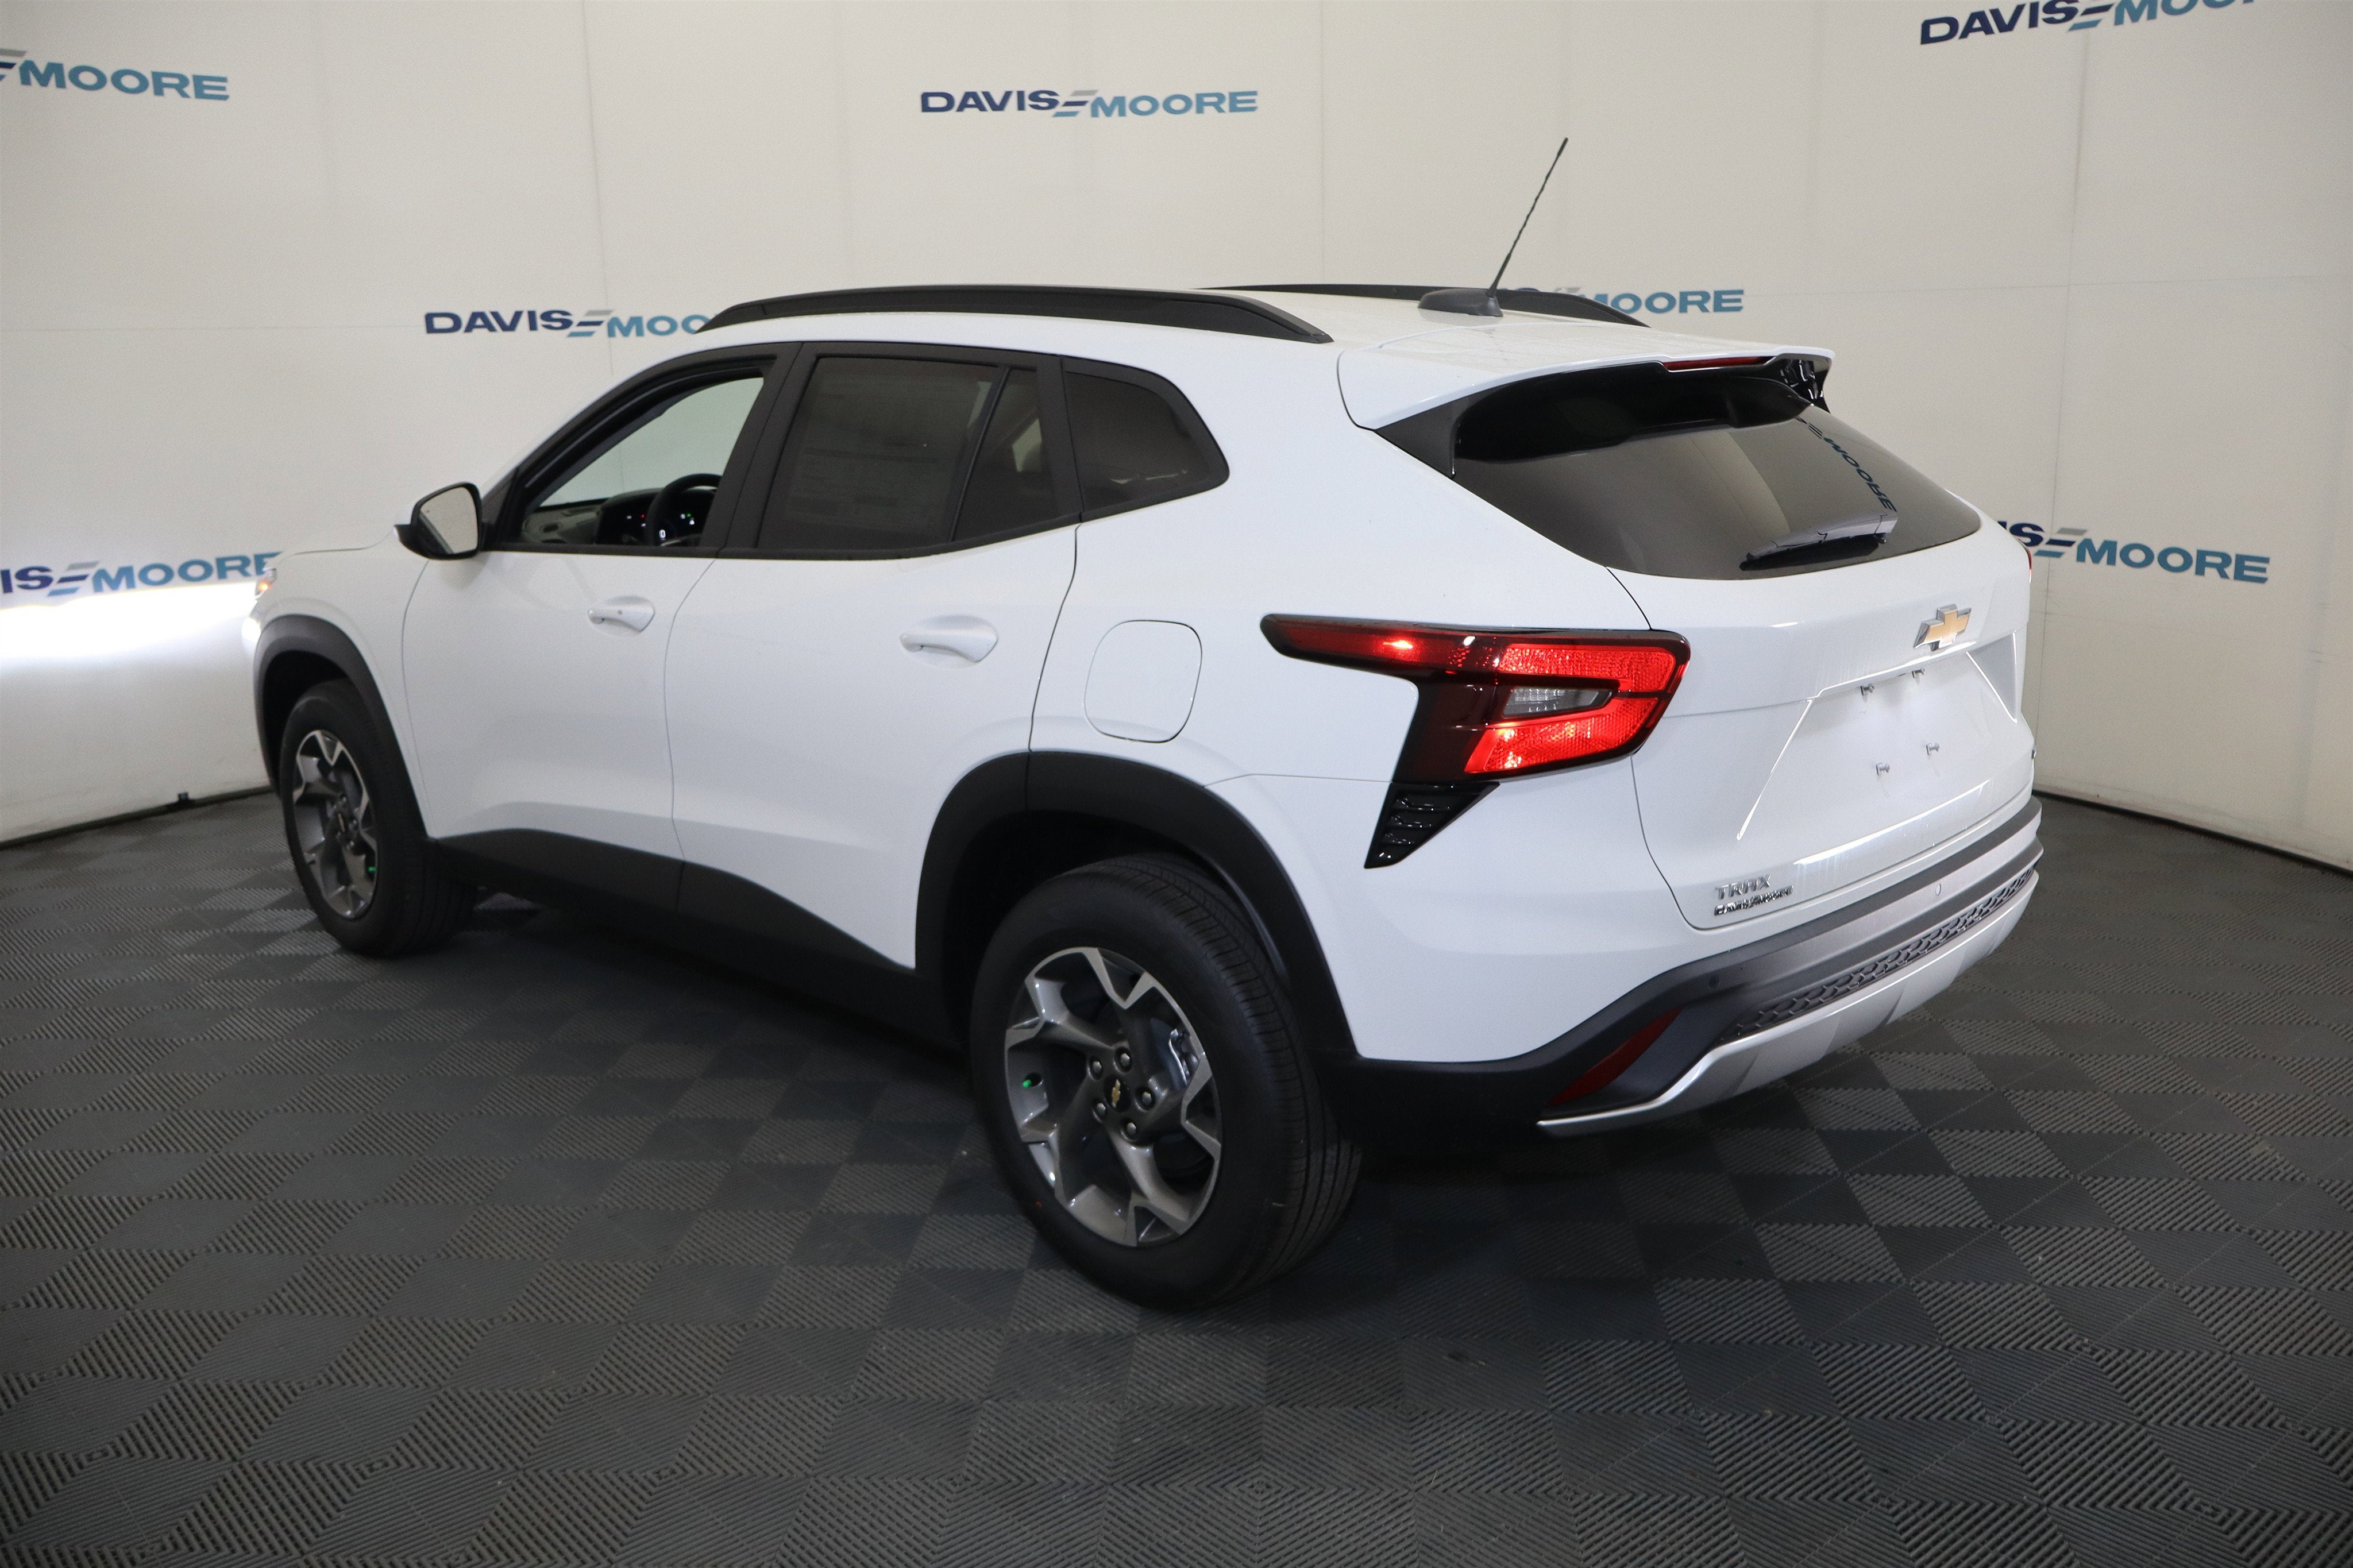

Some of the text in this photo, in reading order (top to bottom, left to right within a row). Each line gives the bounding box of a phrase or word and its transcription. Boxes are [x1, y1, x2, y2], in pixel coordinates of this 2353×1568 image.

[1920, 0, 2078, 45] DAVIS
[18, 59, 230, 101] MOORE
[920, 90, 1259, 118] DAVIS MOORE
[1580, 289, 1745, 314] OORE
[424, 309, 711, 338] DAVIS MOO
[2076, 538, 2270, 584] MOORE
